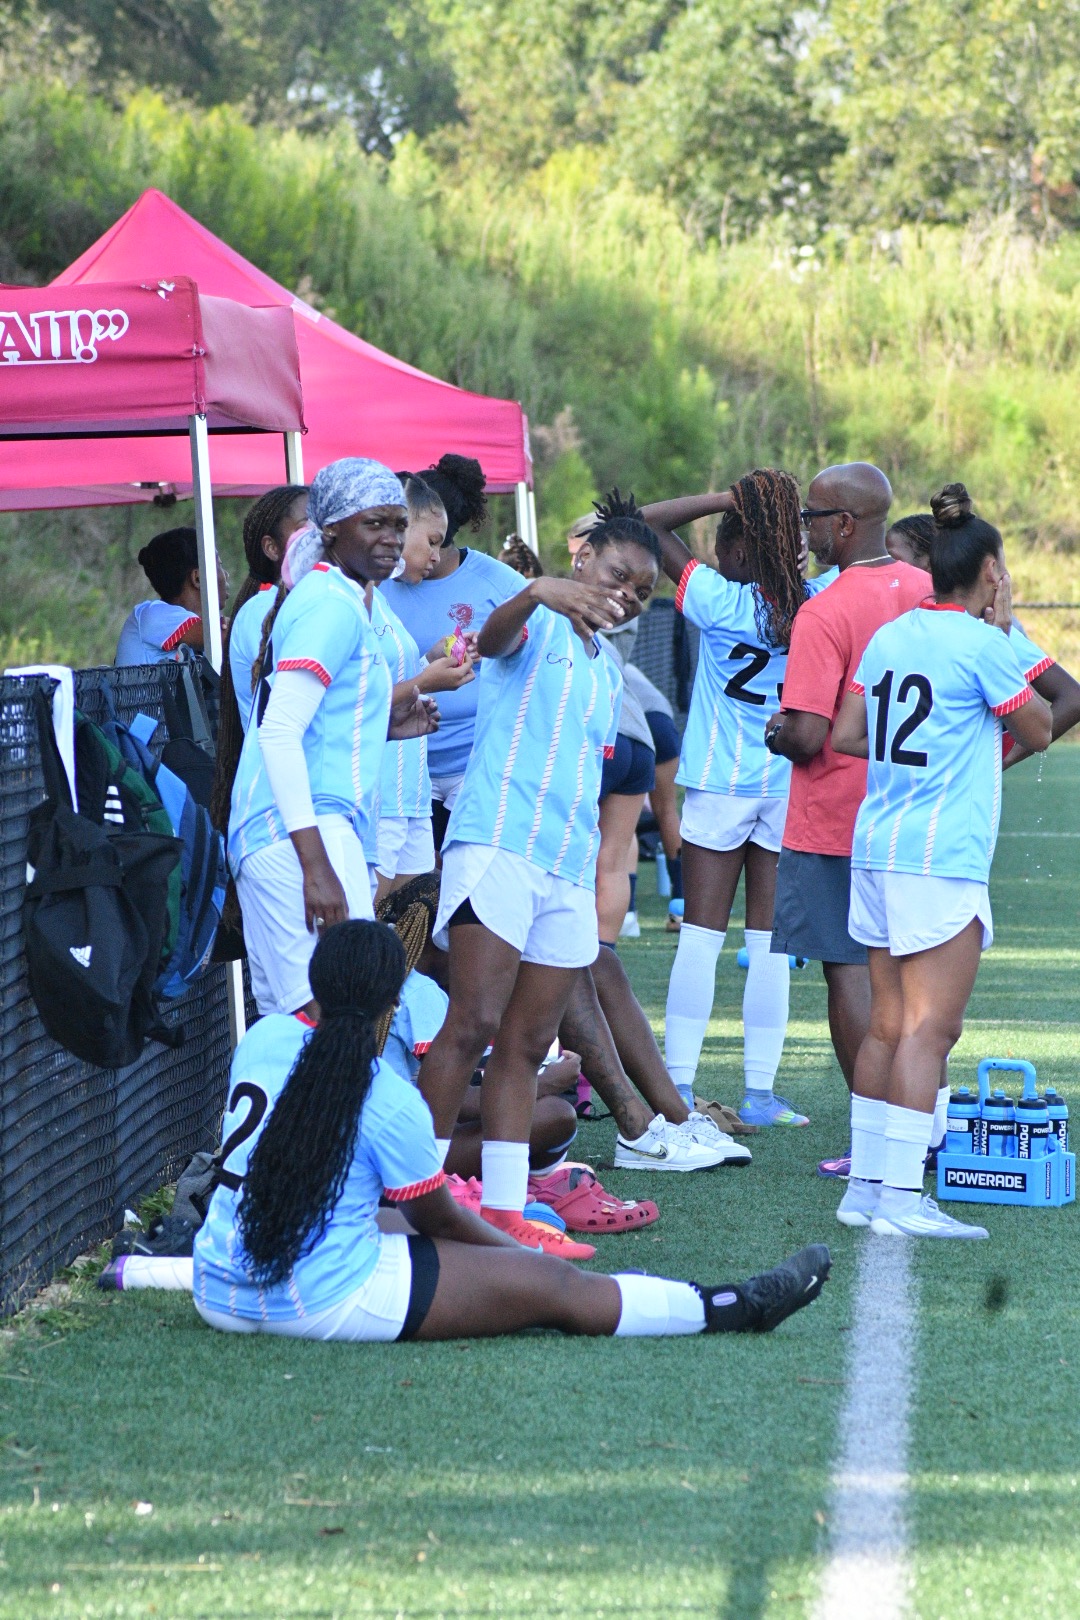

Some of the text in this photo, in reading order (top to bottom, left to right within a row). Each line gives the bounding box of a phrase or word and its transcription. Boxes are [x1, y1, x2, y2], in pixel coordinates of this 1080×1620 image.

[723, 642, 788, 706] 2
[871, 670, 933, 768] 12
[947, 1170, 1023, 1189] POWERADE
